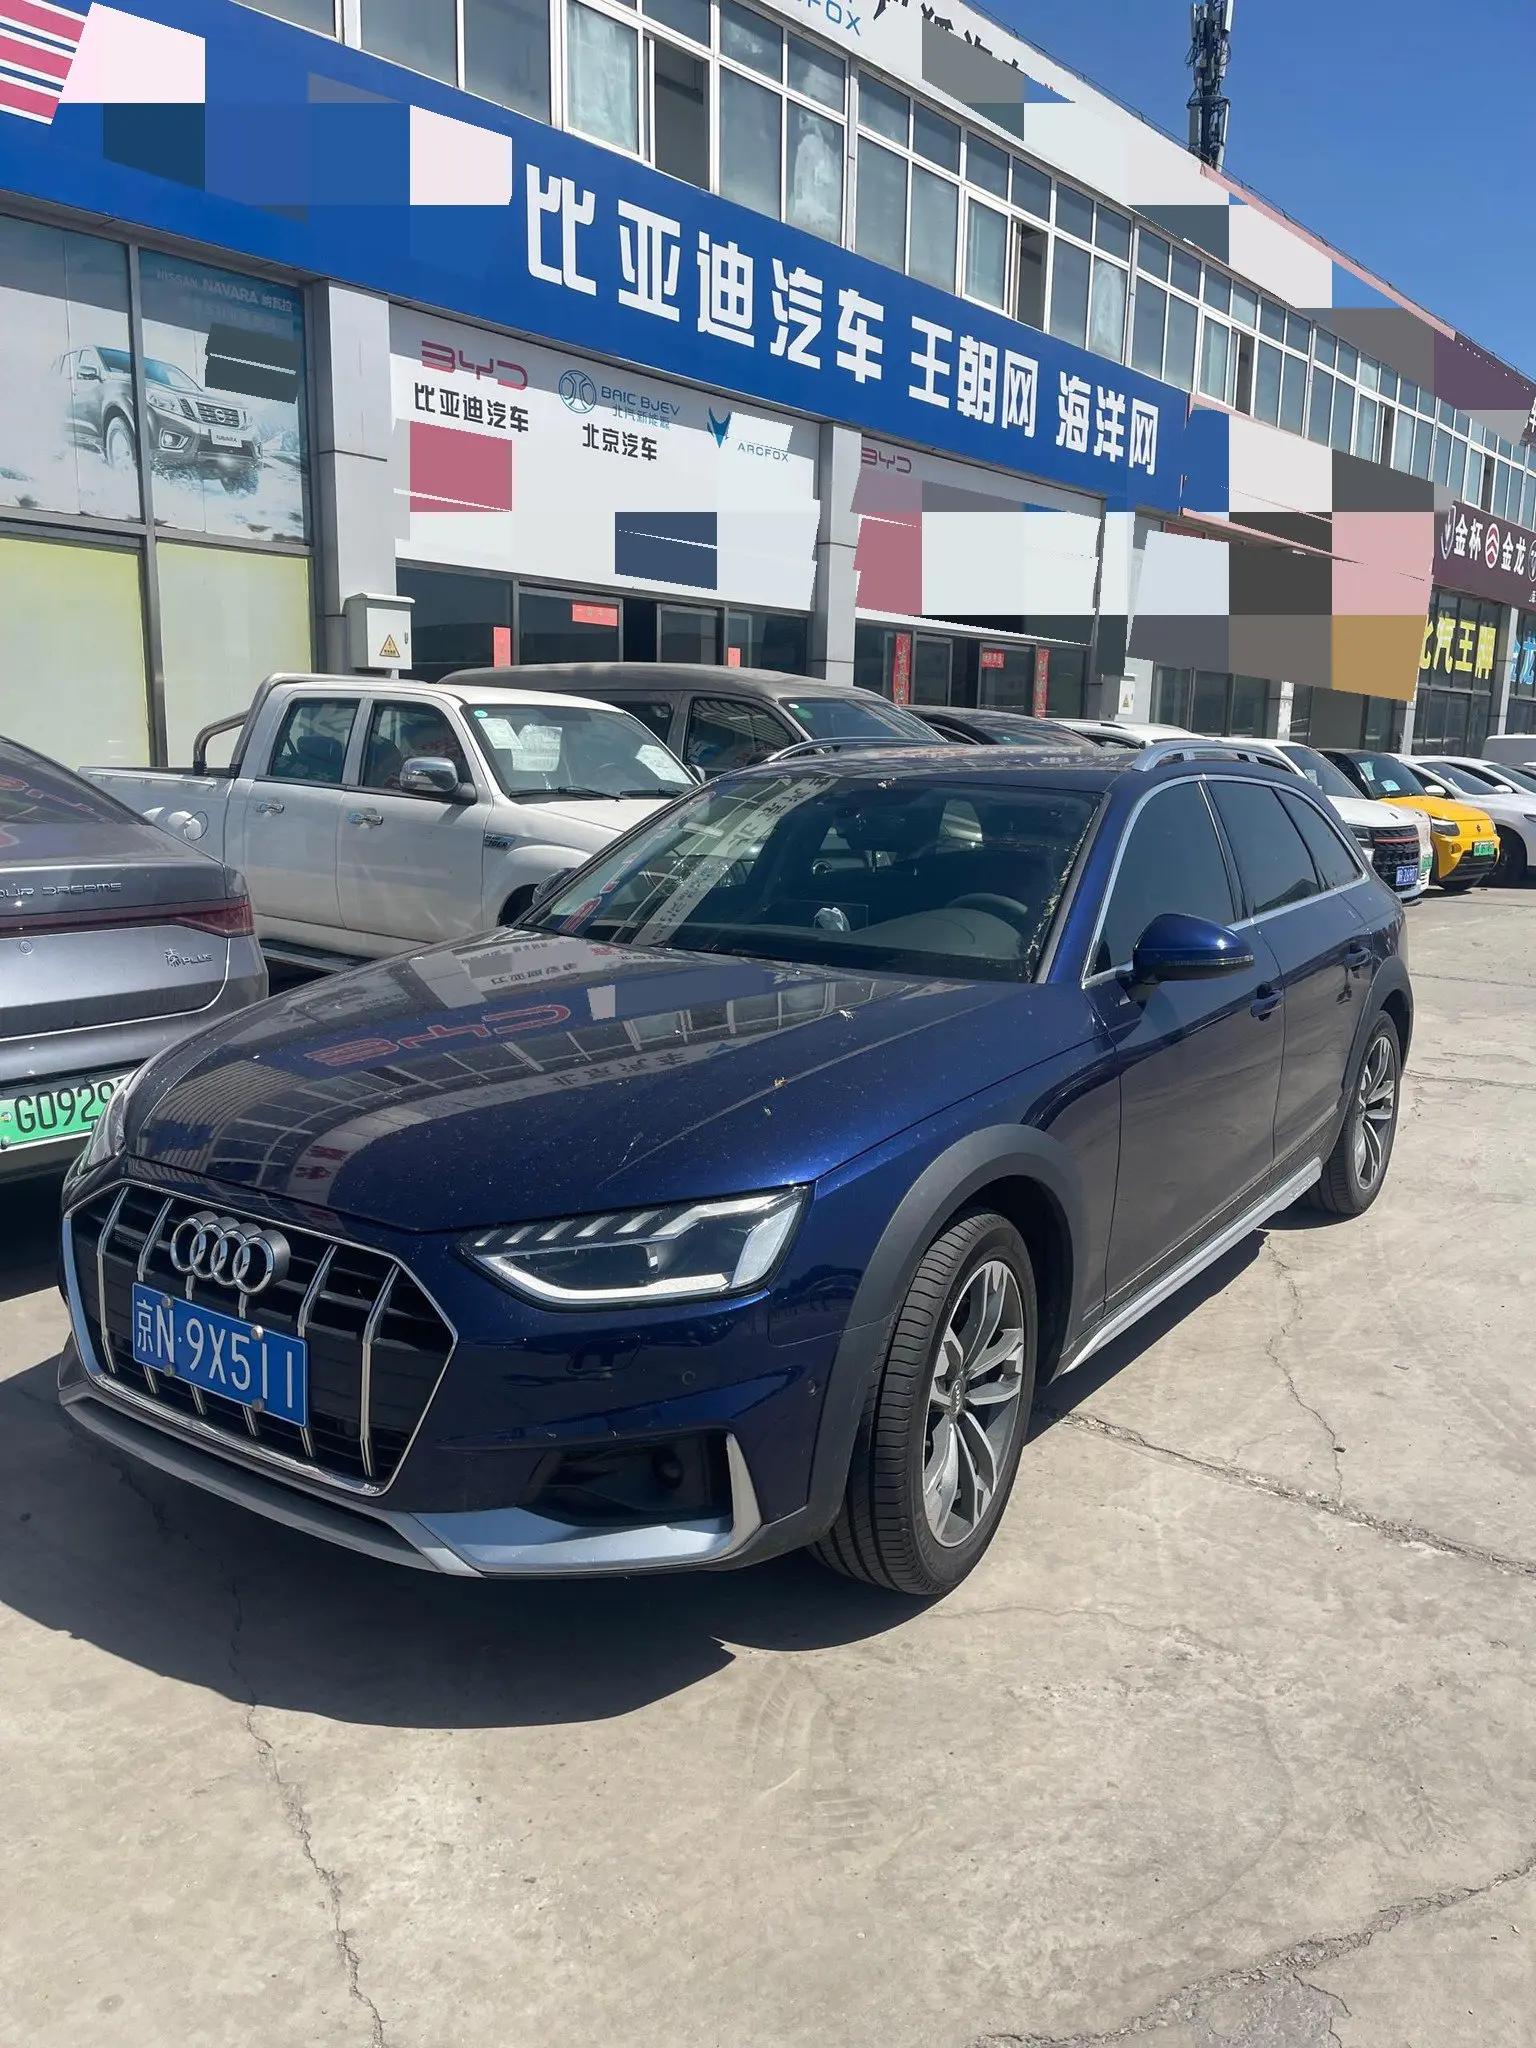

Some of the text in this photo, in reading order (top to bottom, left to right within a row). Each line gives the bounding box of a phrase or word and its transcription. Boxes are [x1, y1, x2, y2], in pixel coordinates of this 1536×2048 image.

[202, 278, 259, 305] NAVARA
[526, 163, 1160, 476] 比亚迪汽车 王朝网 海洋网
[421, 340, 528, 391] BYD
[414, 382, 529, 433] 比亚迪汽车
[601, 385, 680, 416] BAIC BJEV
[582, 422, 657, 461] 北京汽车
[737, 442, 789, 463] ARCFOX
[861, 447, 912, 474] BYD
[1453, 513, 1527, 576] 金杯 金龙
[42, 882, 122, 896] DREAMS
[14, 1078, 123, 1134] G0929
[137, 1299, 293, 1408] 京N·9X511
